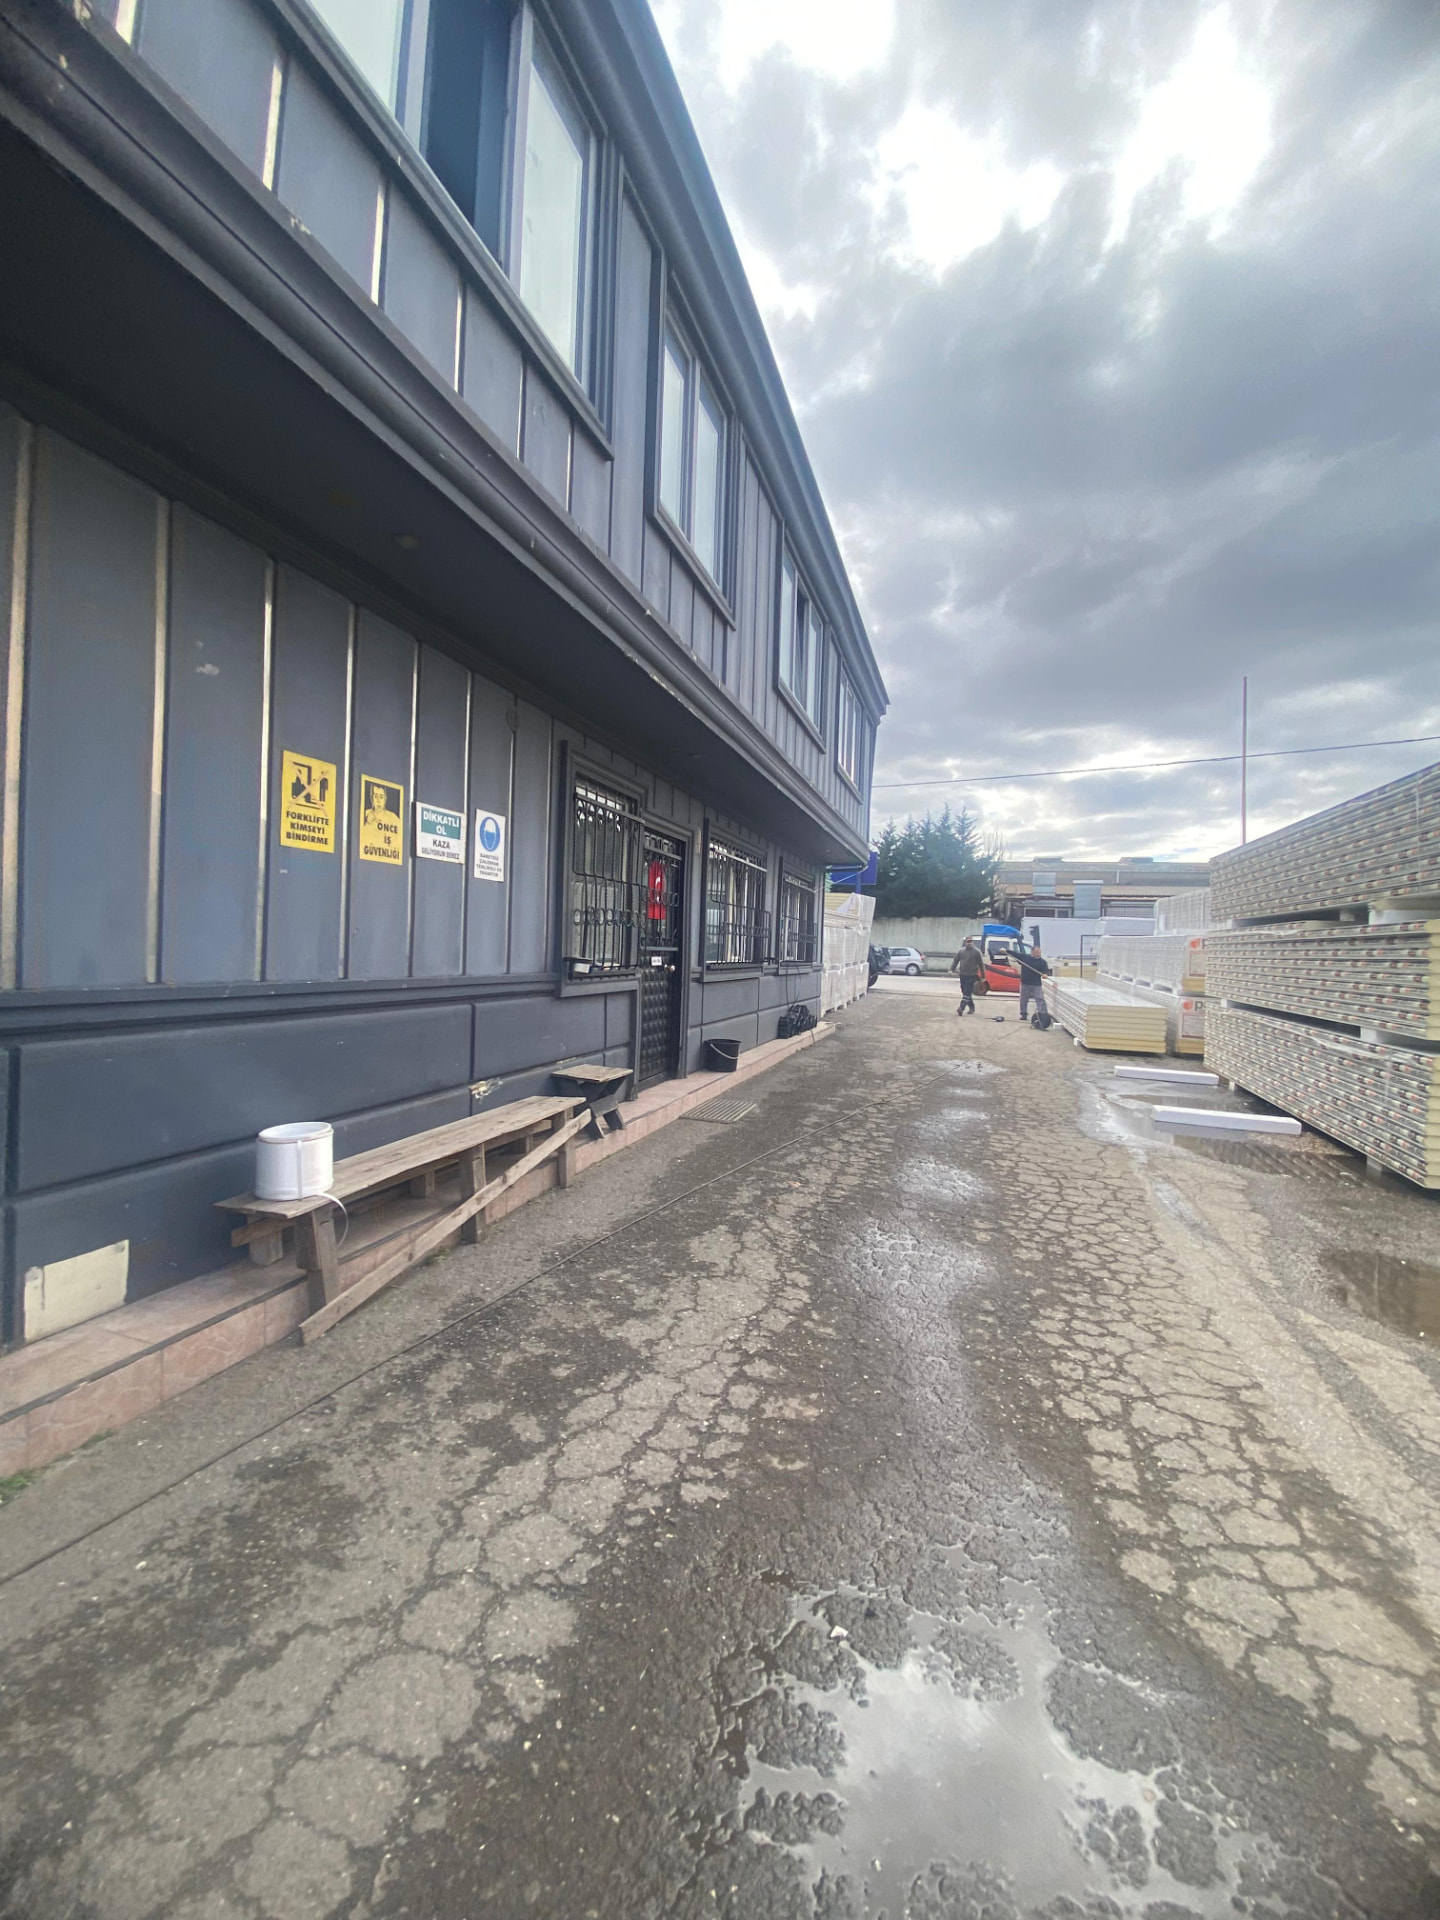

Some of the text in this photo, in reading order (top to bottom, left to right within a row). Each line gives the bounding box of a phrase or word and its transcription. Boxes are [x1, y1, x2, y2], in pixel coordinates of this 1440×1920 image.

[423, 810, 460, 828] DİKKATLİ
[290, 821, 325, 835] KİMSEYİ
[436, 825, 447, 836] OL
[286, 831, 328, 846] BİNDİRME
[432, 839, 450, 849] KAZA
